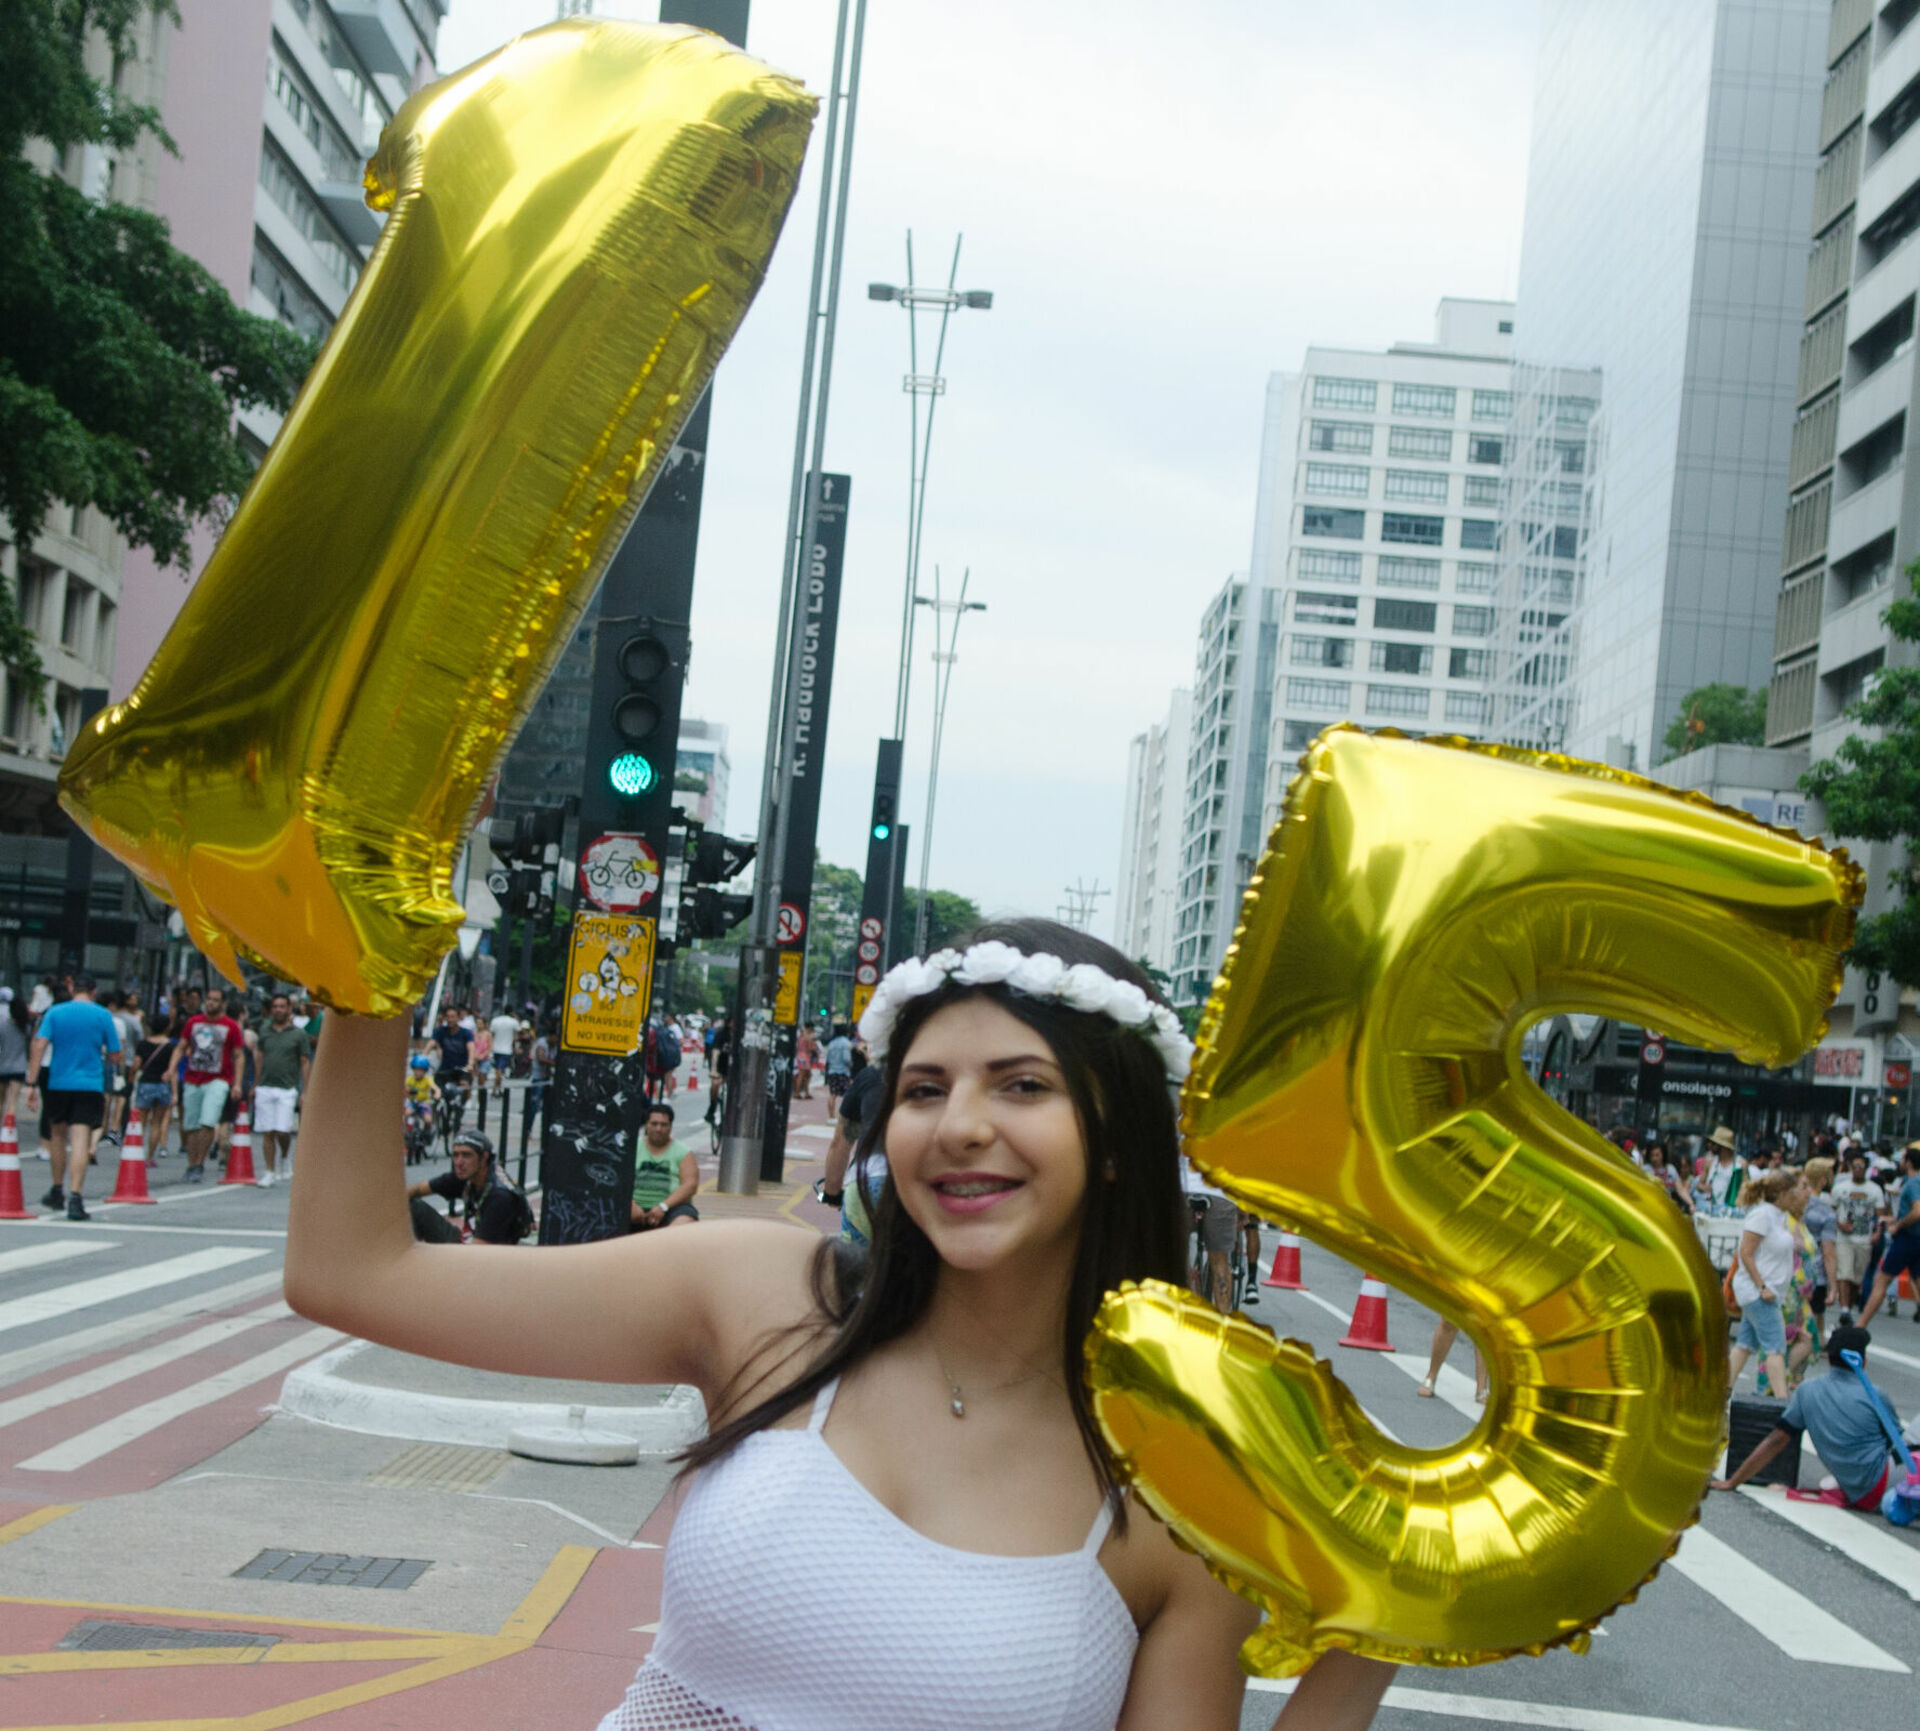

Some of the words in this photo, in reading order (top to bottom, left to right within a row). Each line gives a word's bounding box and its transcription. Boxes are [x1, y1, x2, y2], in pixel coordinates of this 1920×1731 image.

[575, 1015, 636, 1029] ATRAVESSE
[576, 1031, 593, 1040] NO
[595, 1032, 631, 1043] VERDE
